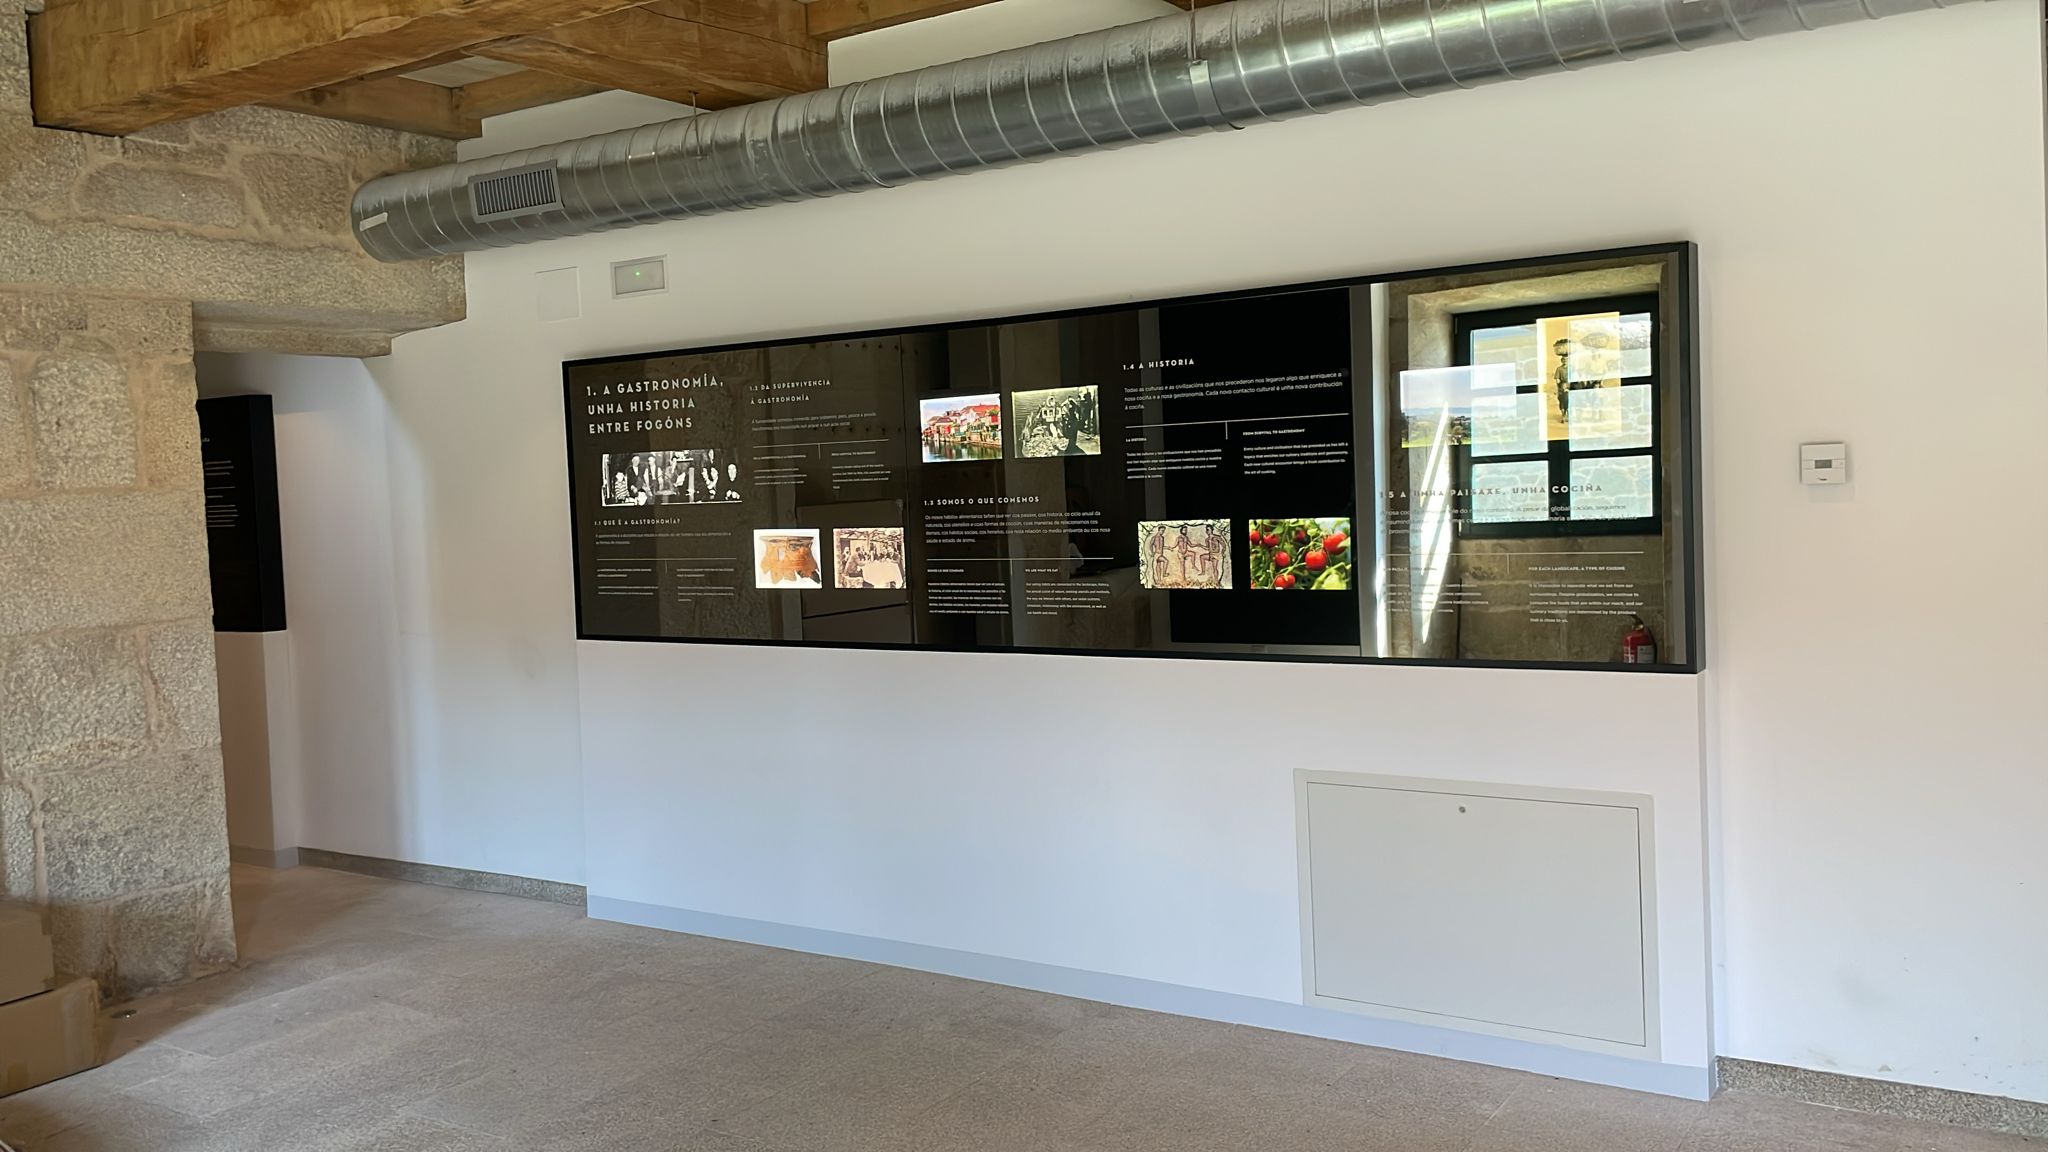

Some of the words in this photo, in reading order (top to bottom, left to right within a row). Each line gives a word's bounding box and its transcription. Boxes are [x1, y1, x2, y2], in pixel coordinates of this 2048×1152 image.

[1138, 362, 1144, 370] A
[1148, 358, 1194, 368] HISTORIA
[586, 386, 596, 396] 1.
[603, 385, 610, 395] A
[617, 374, 724, 394] GASTRONOMÍA,
[773, 380, 830, 390] SUPERVIVENCIA
[757, 394, 809, 404] GASTRONOMÍA
[588, 403, 623, 415] UNHA
[630, 398, 695, 412] HISTORIA
[589, 422, 630, 434] ENTRE
[637, 416, 692, 431] FOGÓNS
[1400, 490, 1406, 498] A
[1552, 484, 1602, 494] COCIÑA
[998, 496, 1040, 504] COMEMOS
